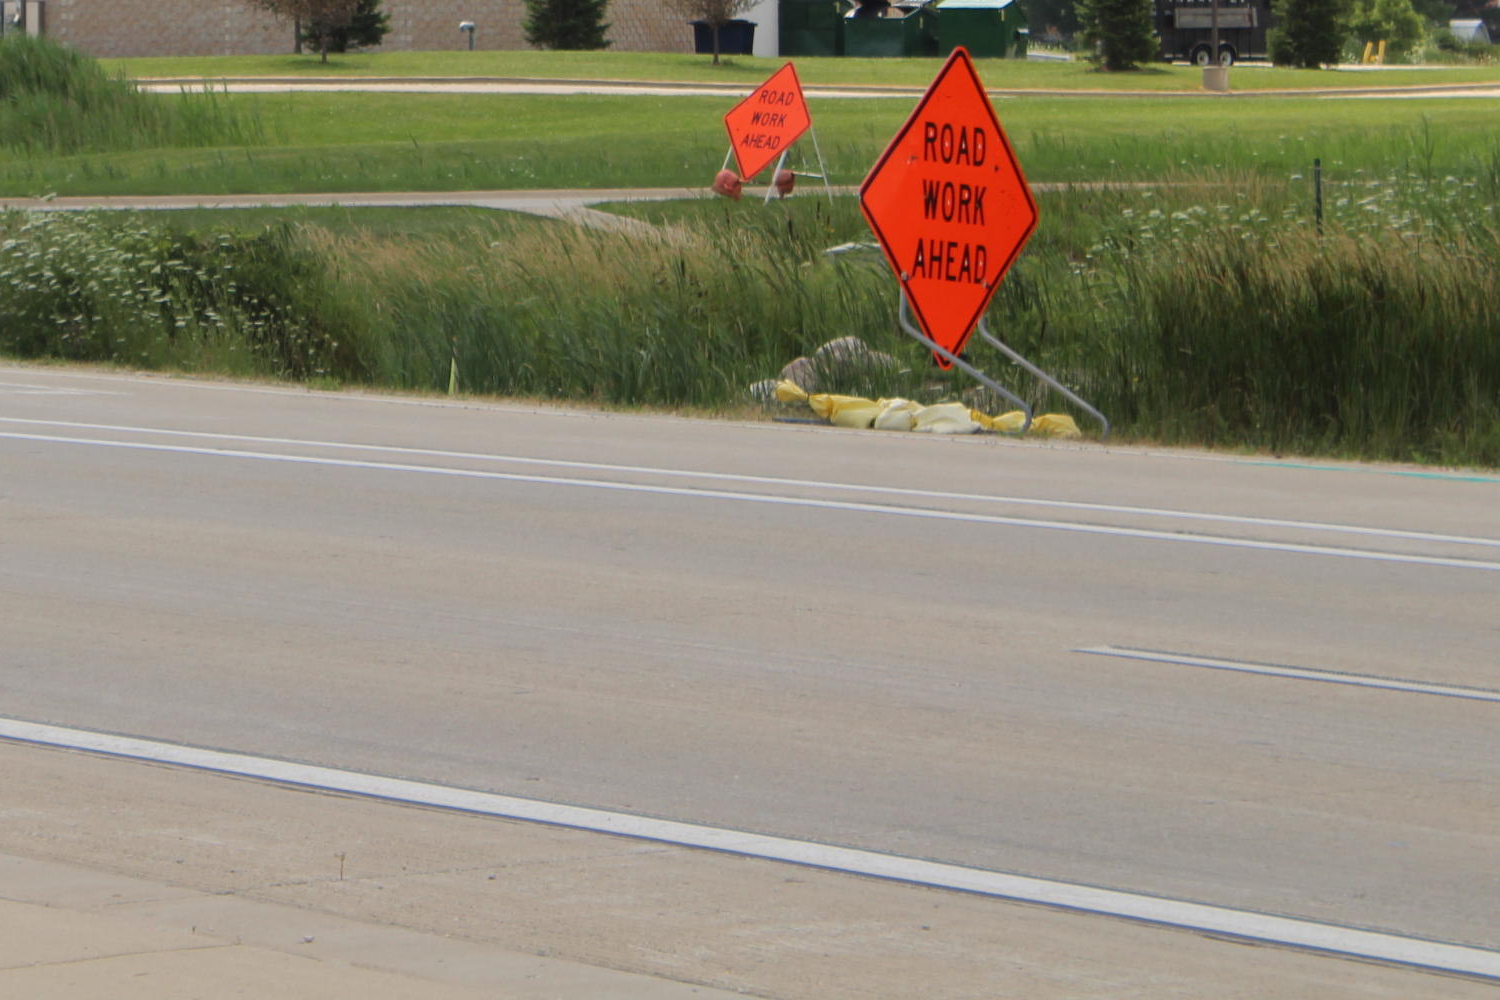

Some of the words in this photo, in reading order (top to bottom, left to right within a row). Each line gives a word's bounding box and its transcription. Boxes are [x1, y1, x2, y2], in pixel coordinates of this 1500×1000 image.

[758, 90, 794, 106] ROAD
[751, 112, 786, 128] WORK
[740, 135, 780, 150] AHEAD
[924, 122, 986, 166] ROAD
[923, 179, 987, 225] WORK
[912, 238, 987, 284] AHEAD
